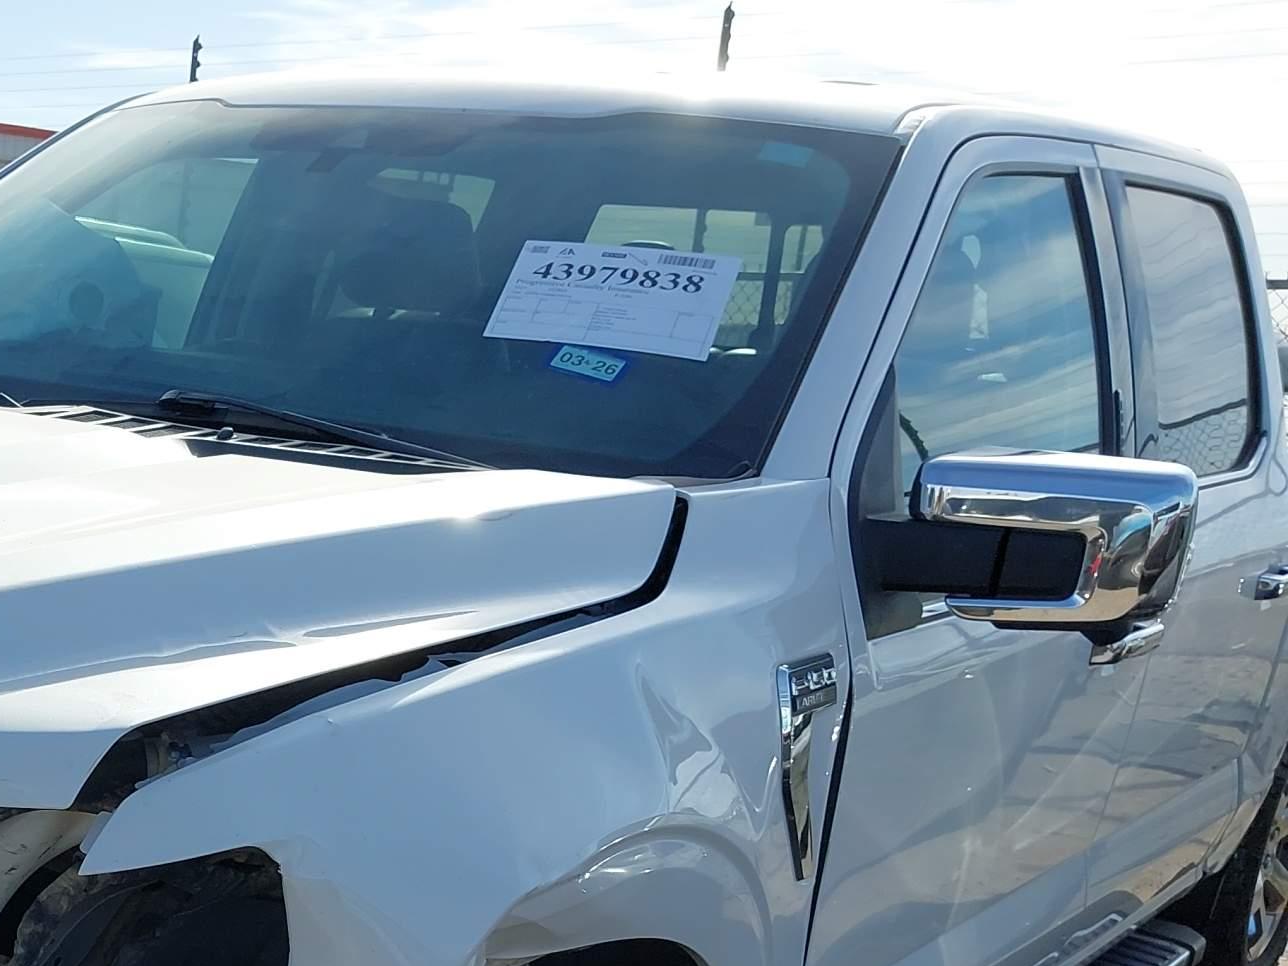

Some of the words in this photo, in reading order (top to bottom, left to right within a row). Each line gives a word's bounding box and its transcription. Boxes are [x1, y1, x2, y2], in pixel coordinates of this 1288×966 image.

[533, 261, 705, 294] 43979838
[559, 351, 585, 367] 03
[592, 360, 618, 375] 26
